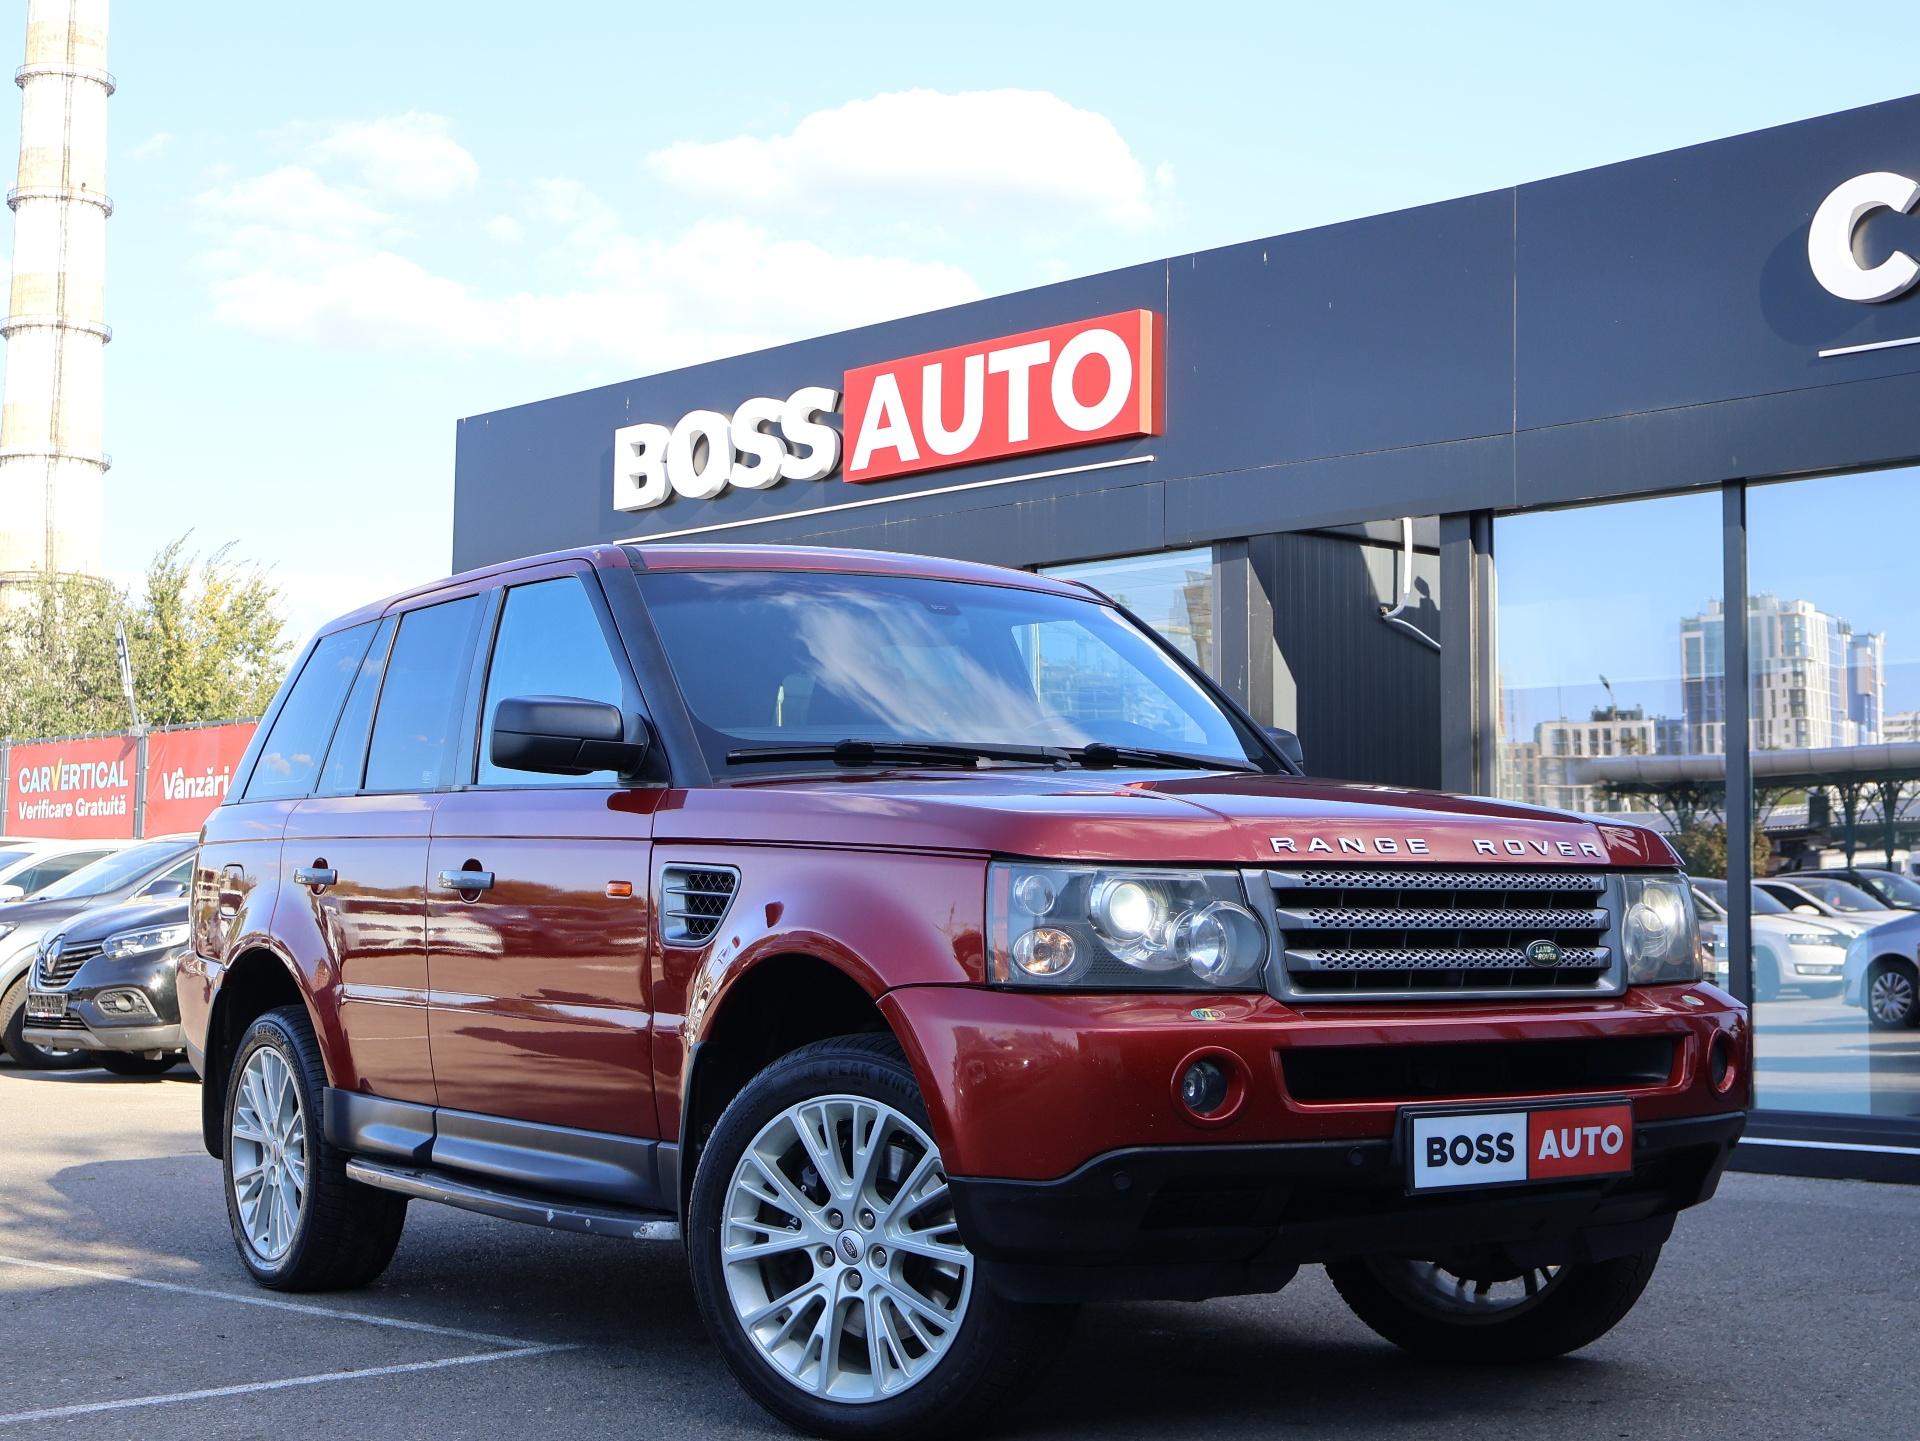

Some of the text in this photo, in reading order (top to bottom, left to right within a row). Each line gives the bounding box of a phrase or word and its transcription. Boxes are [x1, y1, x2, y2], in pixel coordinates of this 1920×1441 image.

[613, 328, 1133, 511] BOSS AUTO
[18, 758, 129, 794] CARVERTICAL
[162, 766, 229, 800] Vânzări
[18, 794, 127, 820] Verificare Gratuită
[1269, 836, 1602, 858] RANGE ROVER
[1426, 1124, 1624, 1168] BOSS AUTO
